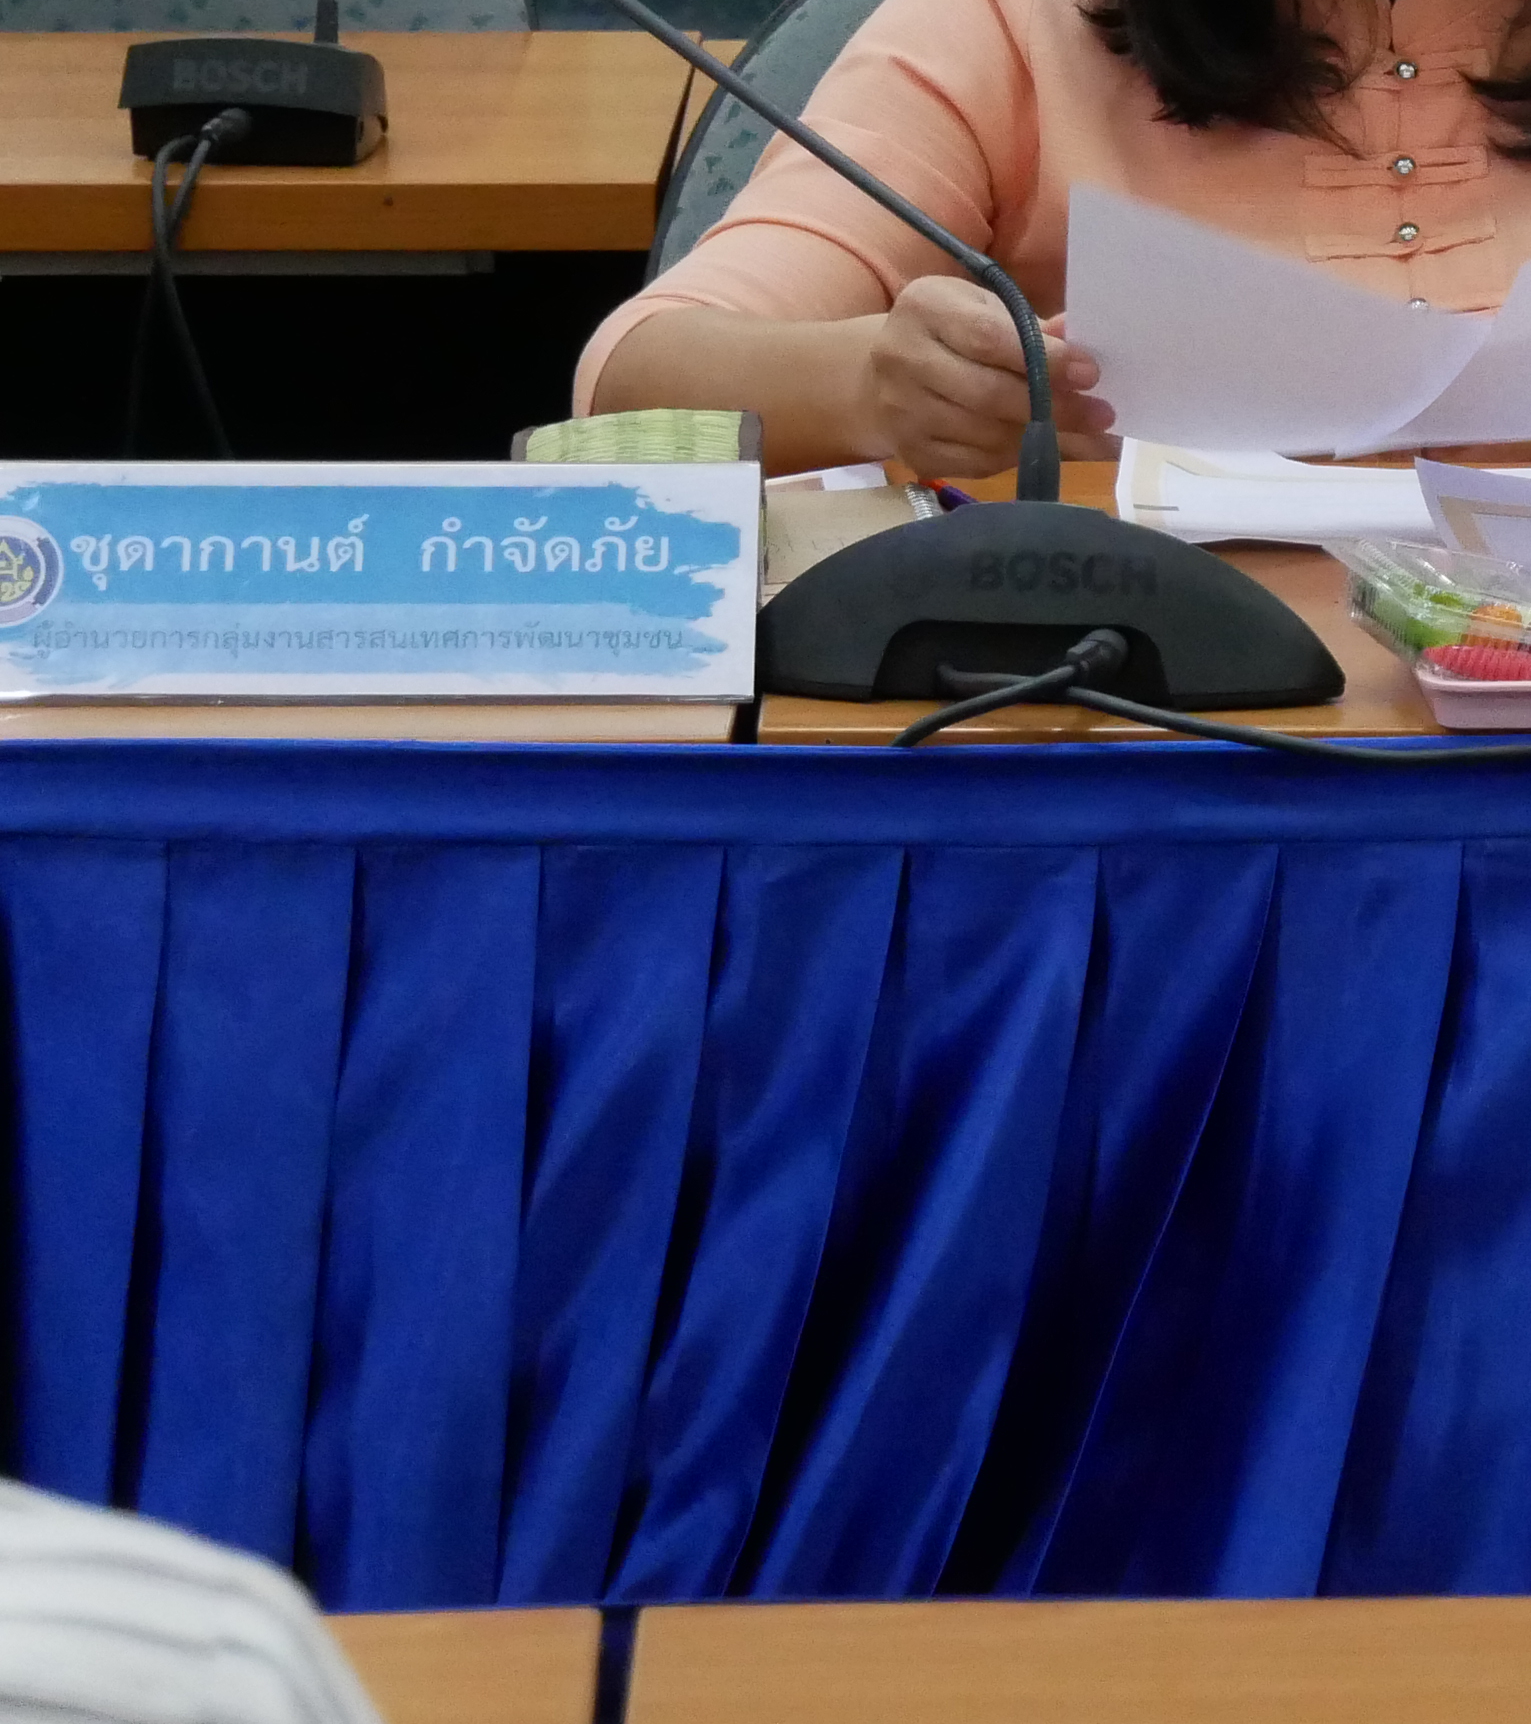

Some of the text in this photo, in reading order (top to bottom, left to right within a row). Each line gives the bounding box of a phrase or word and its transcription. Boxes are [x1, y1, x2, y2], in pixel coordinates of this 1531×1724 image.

[172, 57, 309, 95] BOSCH
[70, 513, 671, 591] ชุดากานต์ กำจัดภัย
[968, 548, 1160, 598] BOSCH
